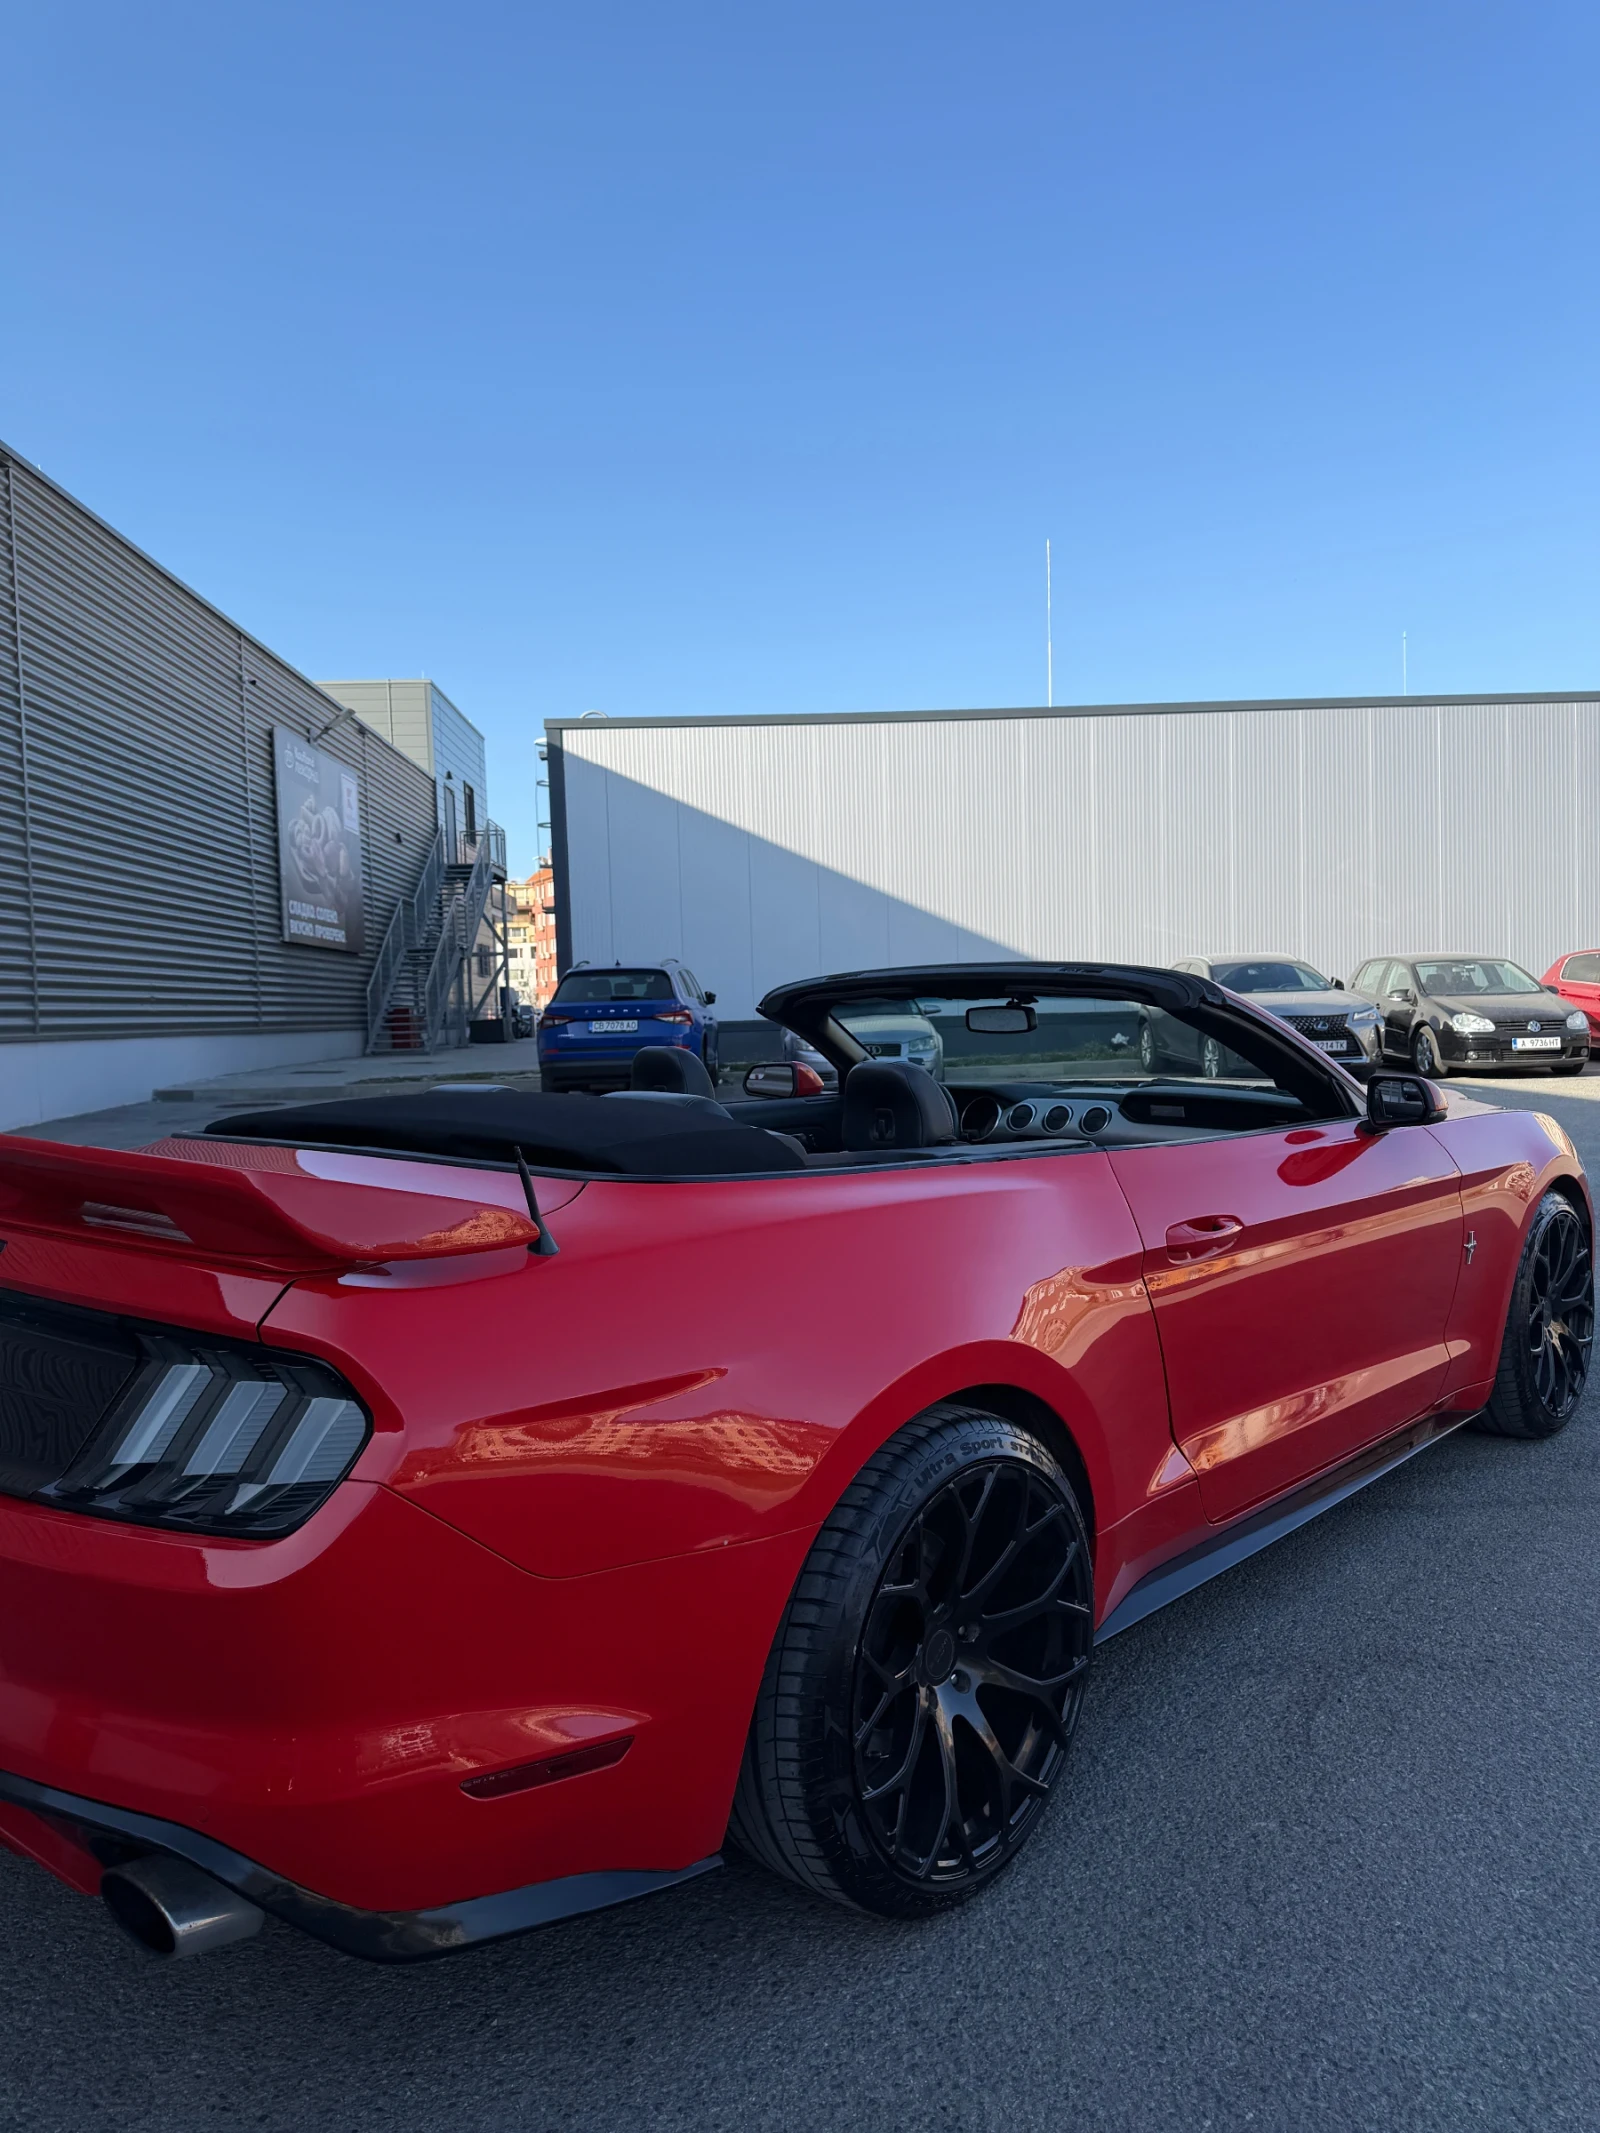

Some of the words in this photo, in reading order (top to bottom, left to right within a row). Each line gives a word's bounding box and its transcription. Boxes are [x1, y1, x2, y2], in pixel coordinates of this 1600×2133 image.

[605, 1020, 625, 1030] 7078
[1335, 1040, 1345, 1050] TK
[1530, 1039, 1548, 1047] 9736
[913, 1450, 957, 1489] Ultra
[959, 1436, 1004, 1457] Sport
